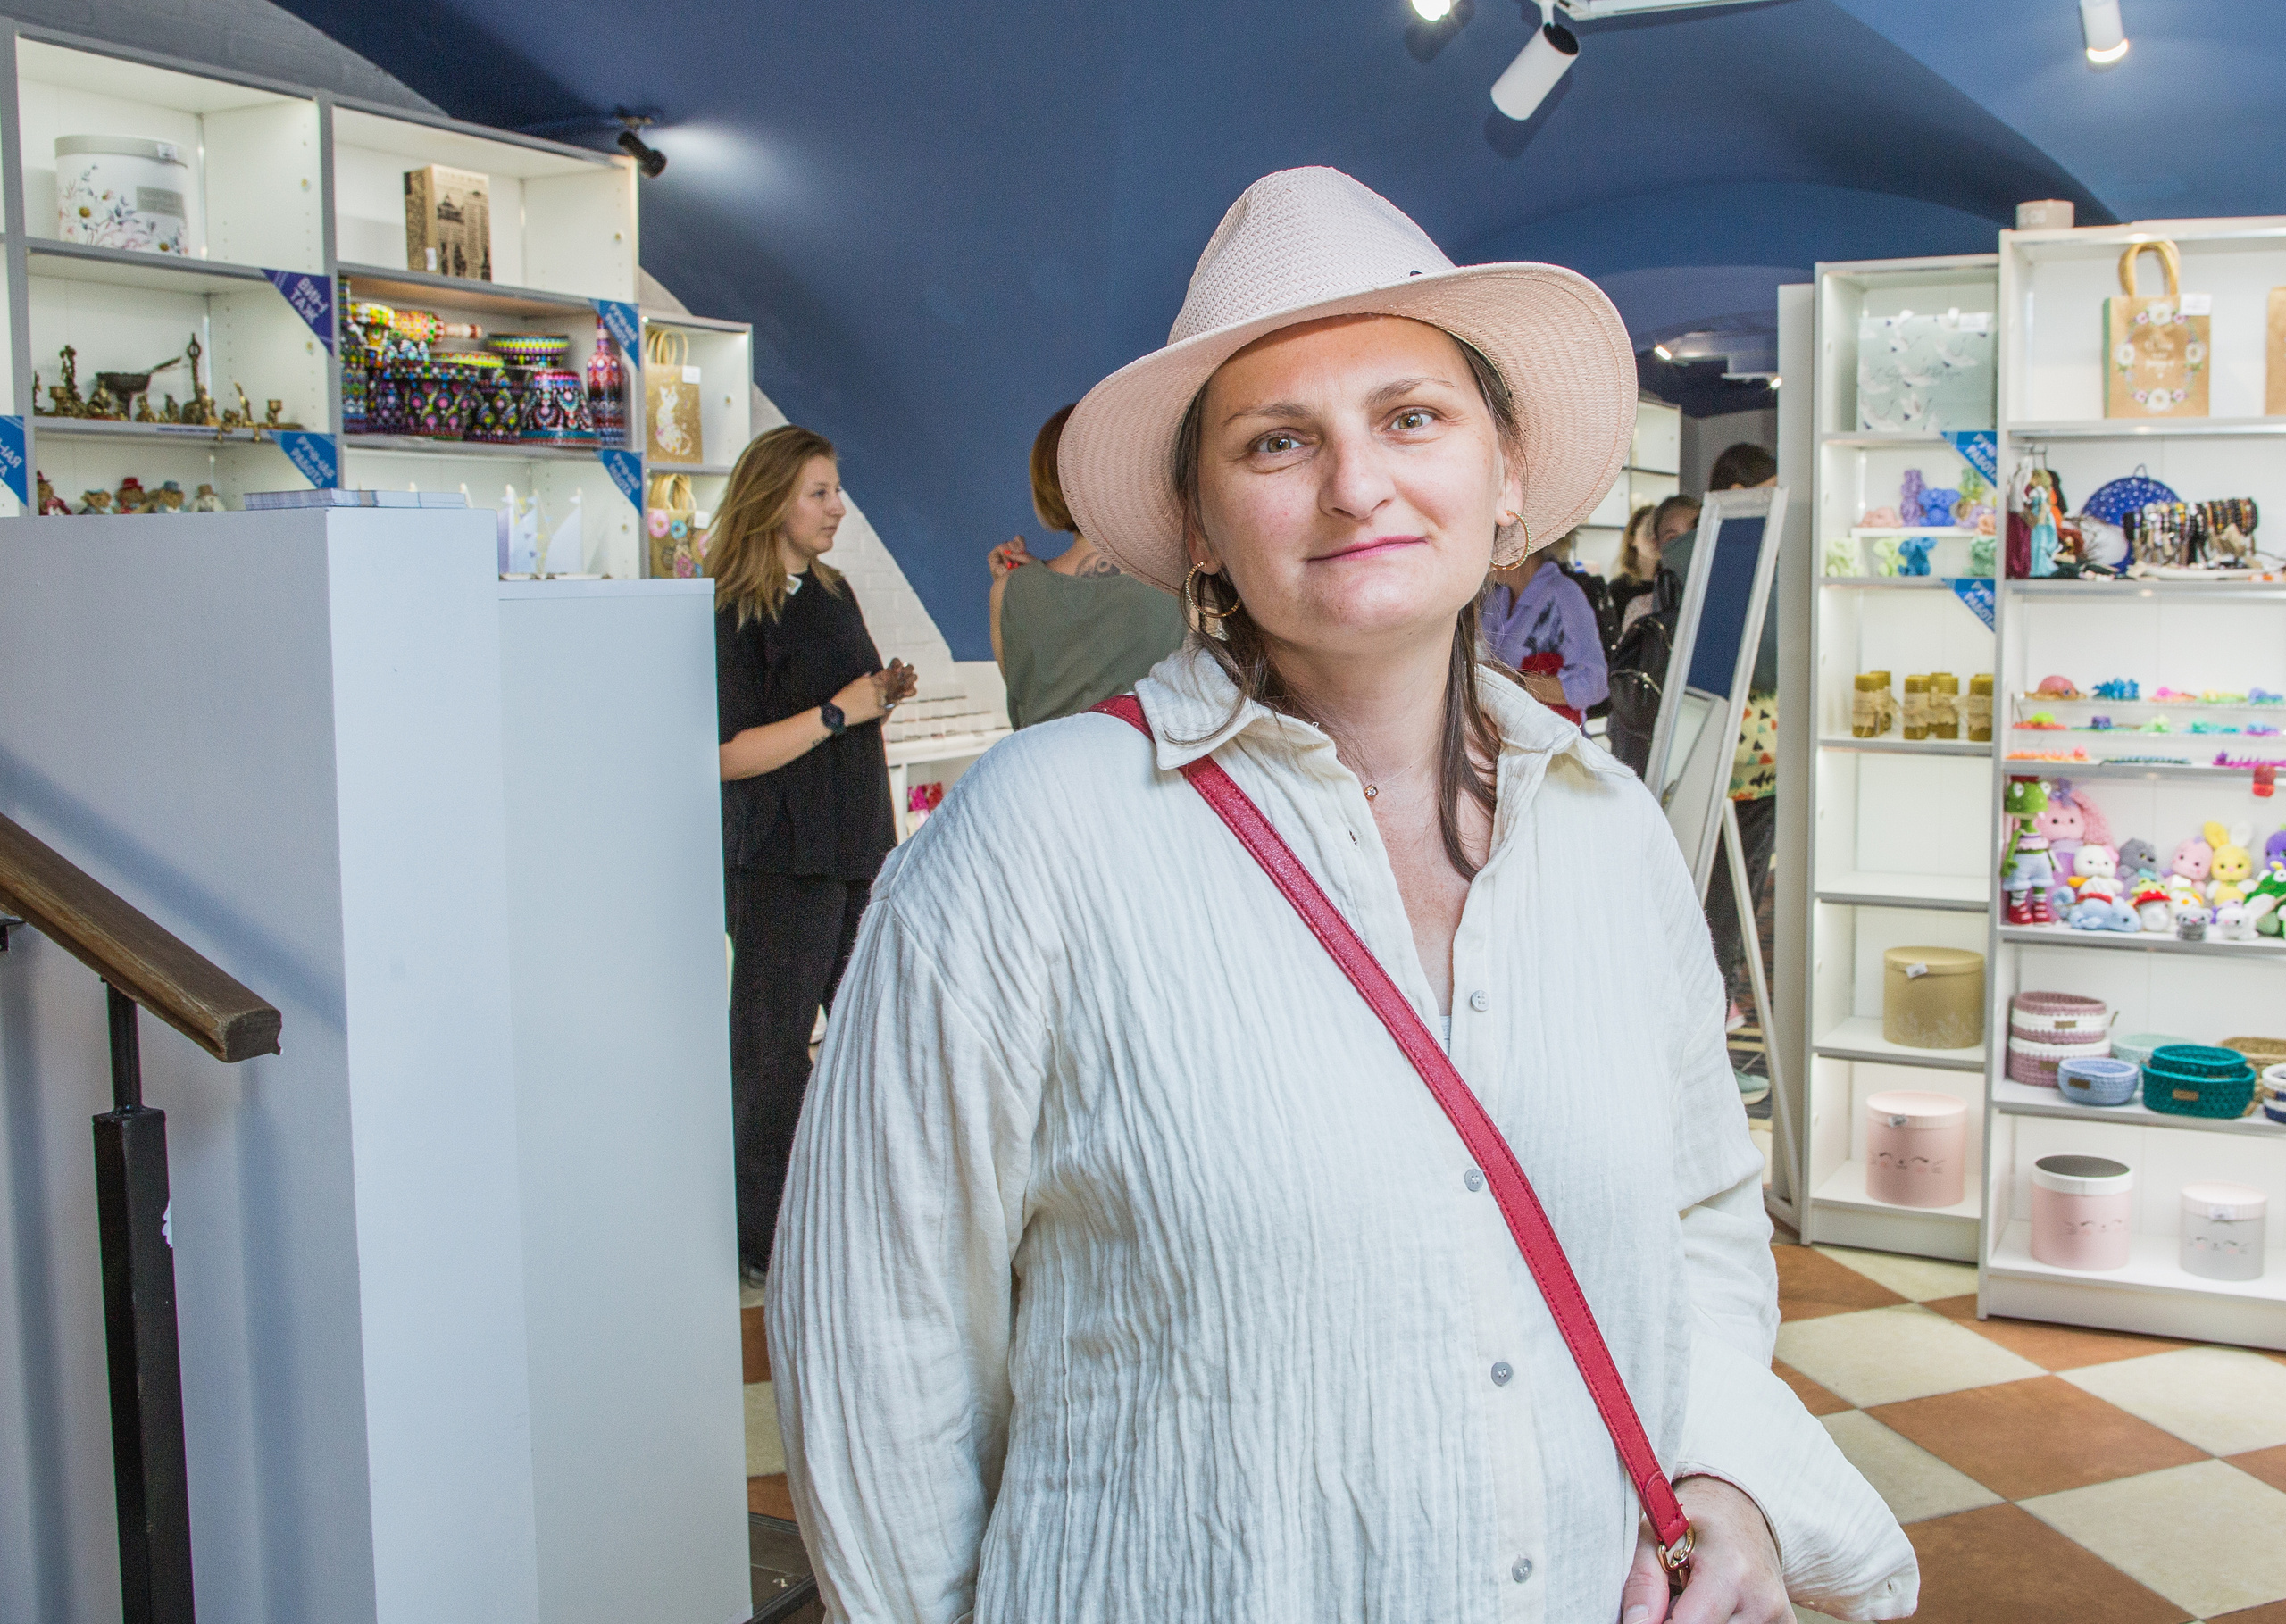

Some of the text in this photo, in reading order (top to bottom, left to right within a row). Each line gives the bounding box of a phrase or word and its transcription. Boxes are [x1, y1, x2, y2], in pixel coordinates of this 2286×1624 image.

[290, 287, 319, 325] ТАЖ
[297, 276, 330, 314] ВИН
[289, 447, 324, 488] РАБОТА
[296, 435, 335, 479] РУЧНАЯ
